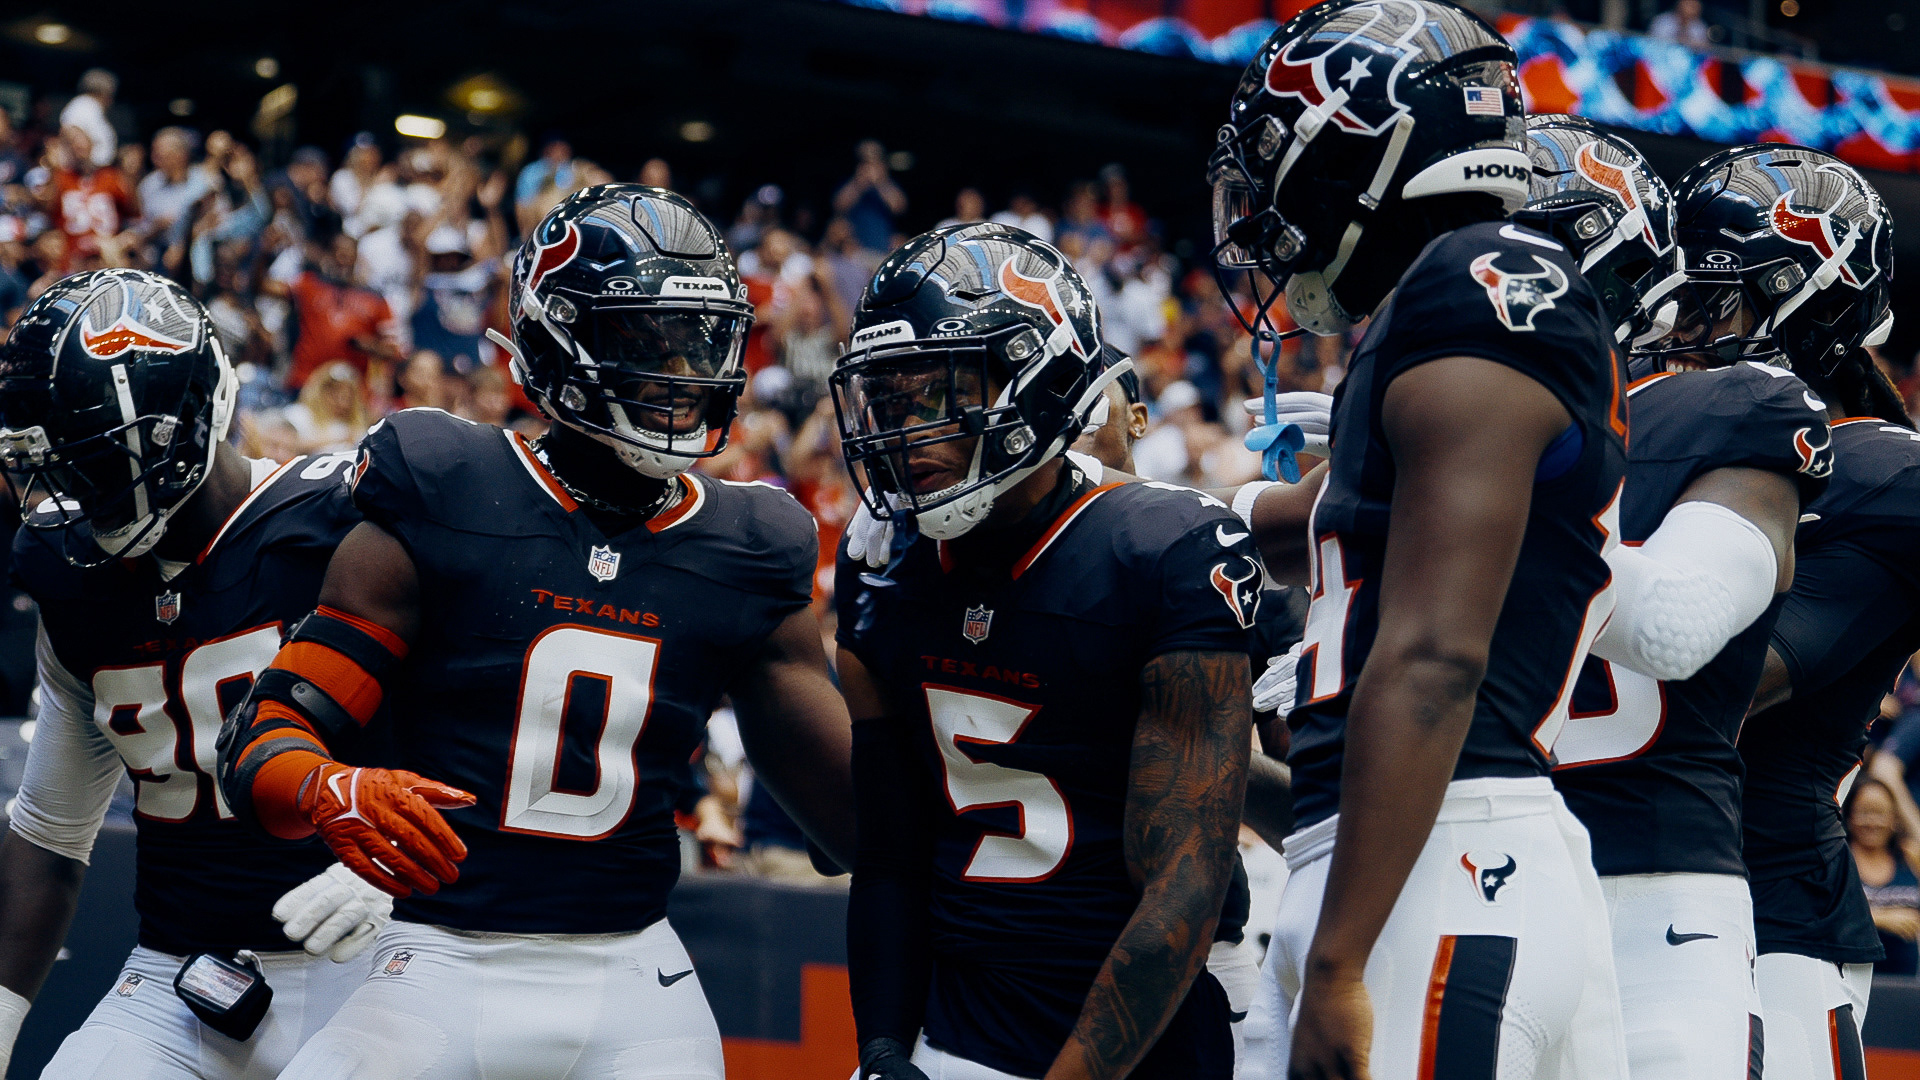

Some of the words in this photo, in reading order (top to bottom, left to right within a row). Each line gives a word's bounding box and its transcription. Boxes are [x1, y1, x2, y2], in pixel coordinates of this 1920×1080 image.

[672, 281, 724, 292] TEXANS
[855, 326, 902, 343] TEXANS
[931, 330, 975, 339] OAKLEY
[593, 560, 612, 576] NFL
[160, 604, 178, 620] NFL
[531, 589, 660, 628] TEXANS
[967, 621, 986, 637] NFL
[920, 655, 1040, 689] TEXANS
[498, 622, 662, 842] 0
[921, 682, 1075, 884] 5
